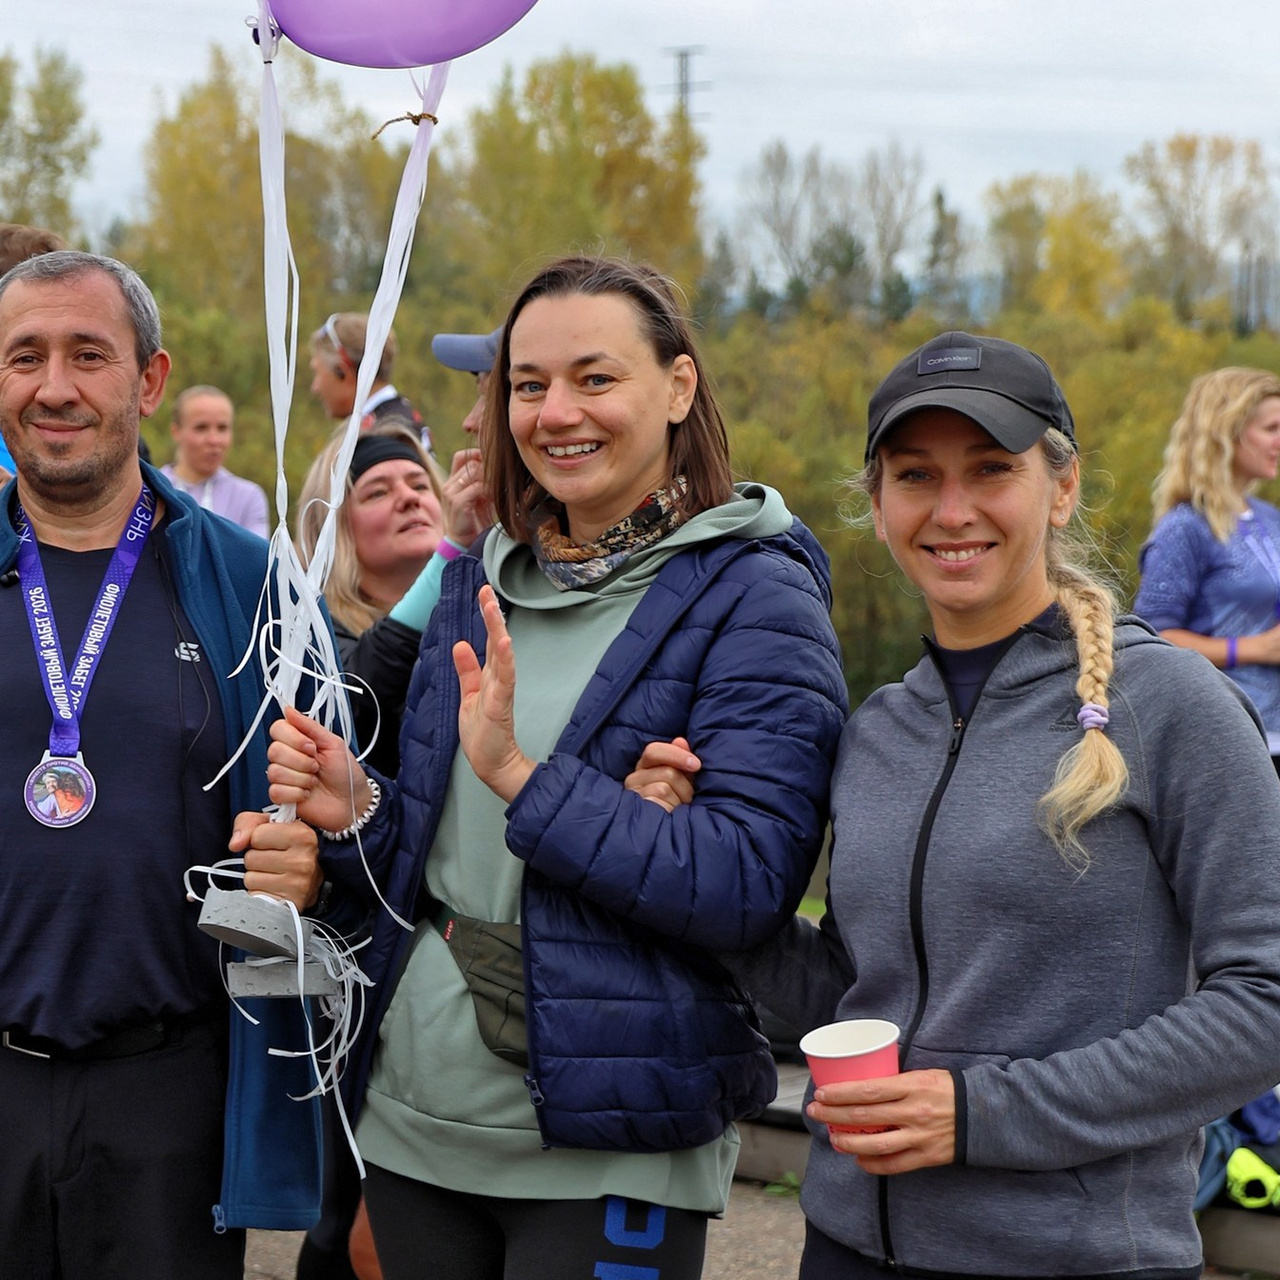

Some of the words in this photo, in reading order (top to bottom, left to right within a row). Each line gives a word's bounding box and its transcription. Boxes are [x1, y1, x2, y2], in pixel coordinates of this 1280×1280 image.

[28, 586, 49, 615] 2026
[35, 617, 56, 648] ЗАБЕГ
[83, 583, 120, 655] ФИОЛЕТОВЫЙ
[39, 648, 73, 720] ФИОЛЕТОВЫЙ
[71, 653, 94, 688] ЗАБЕГ
